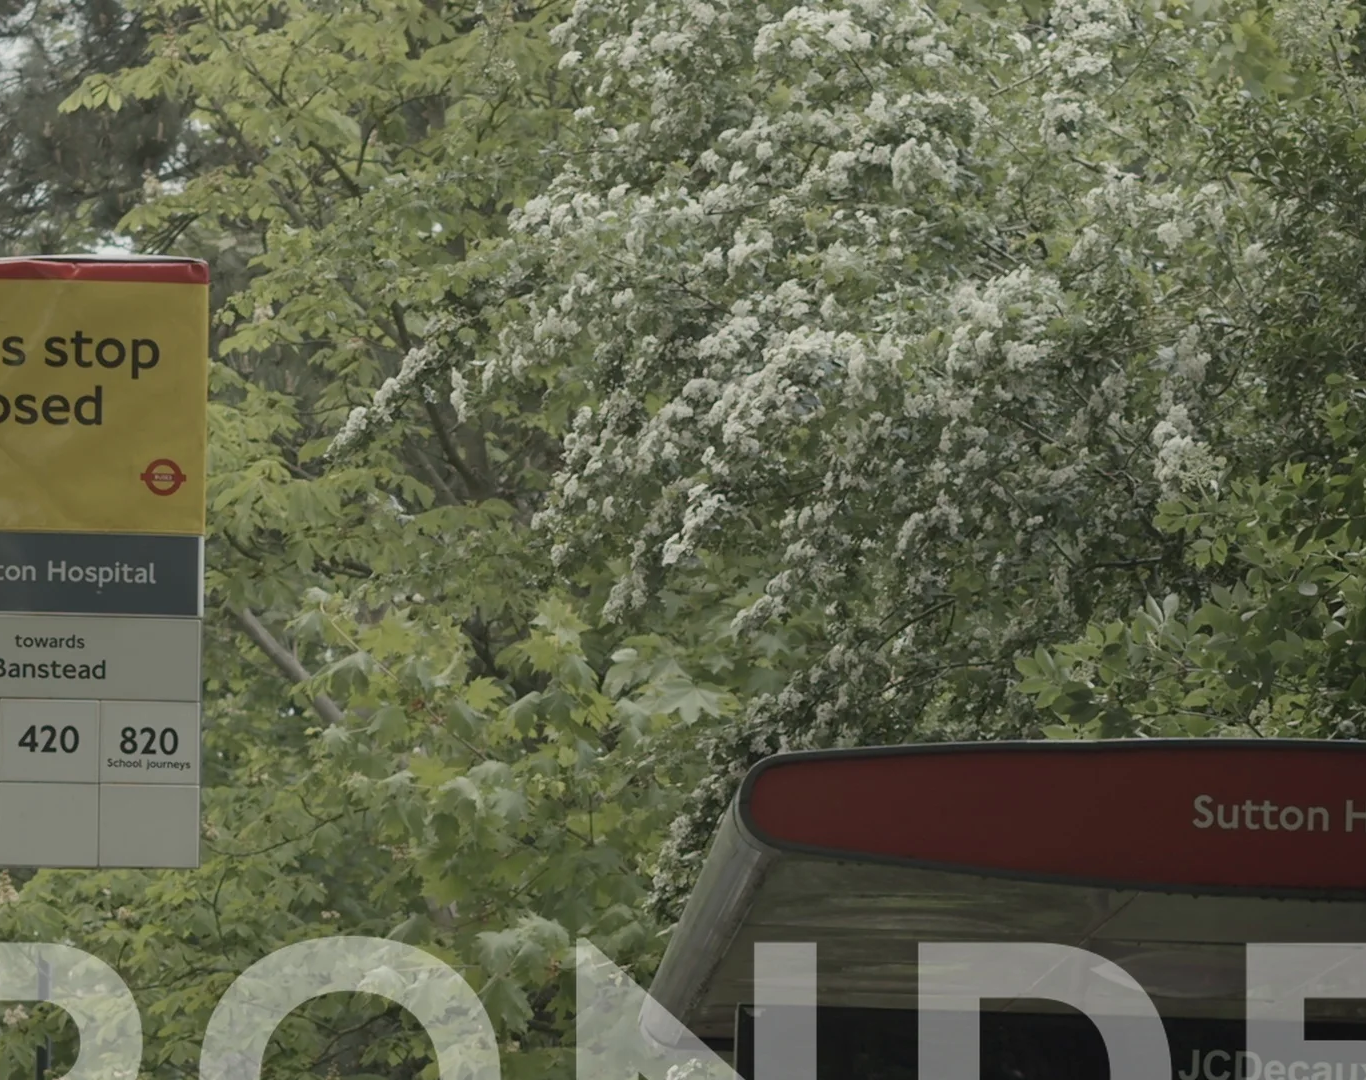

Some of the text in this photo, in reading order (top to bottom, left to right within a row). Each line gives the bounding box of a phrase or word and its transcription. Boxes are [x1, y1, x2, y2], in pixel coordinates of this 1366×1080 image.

[44, 330, 160, 379] stop
[48, 560, 156, 588] Hospital
[15, 633, 85, 650] towards
[18, 725, 80, 755] 420
[119, 728, 179, 756] 820
[107, 759, 191, 772] School journeys
[1191, 795, 1331, 835] Sutton
